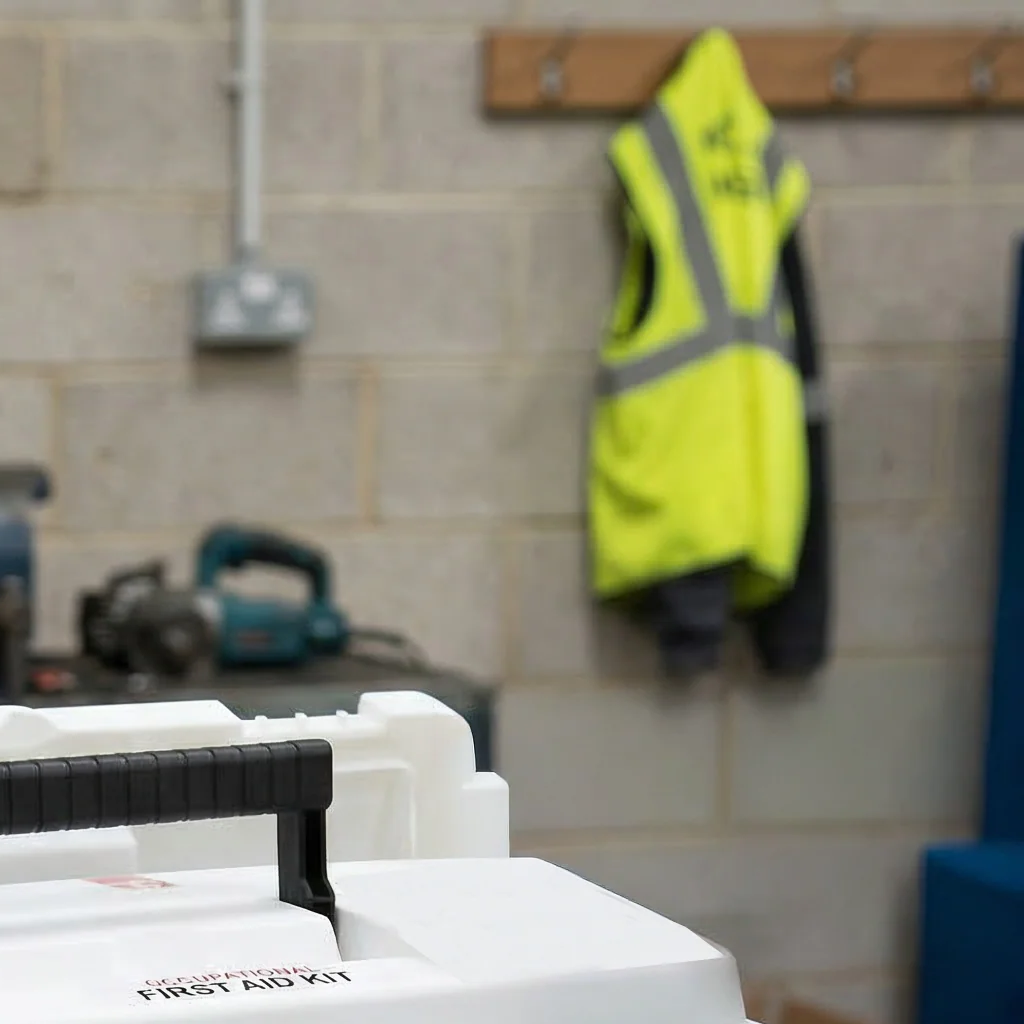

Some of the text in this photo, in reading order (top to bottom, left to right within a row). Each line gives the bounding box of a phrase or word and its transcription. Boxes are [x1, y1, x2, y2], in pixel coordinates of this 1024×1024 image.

[137, 971, 352, 1001] FIRST AID KIT
[145, 965, 318, 987] OCCUPATIONAL
